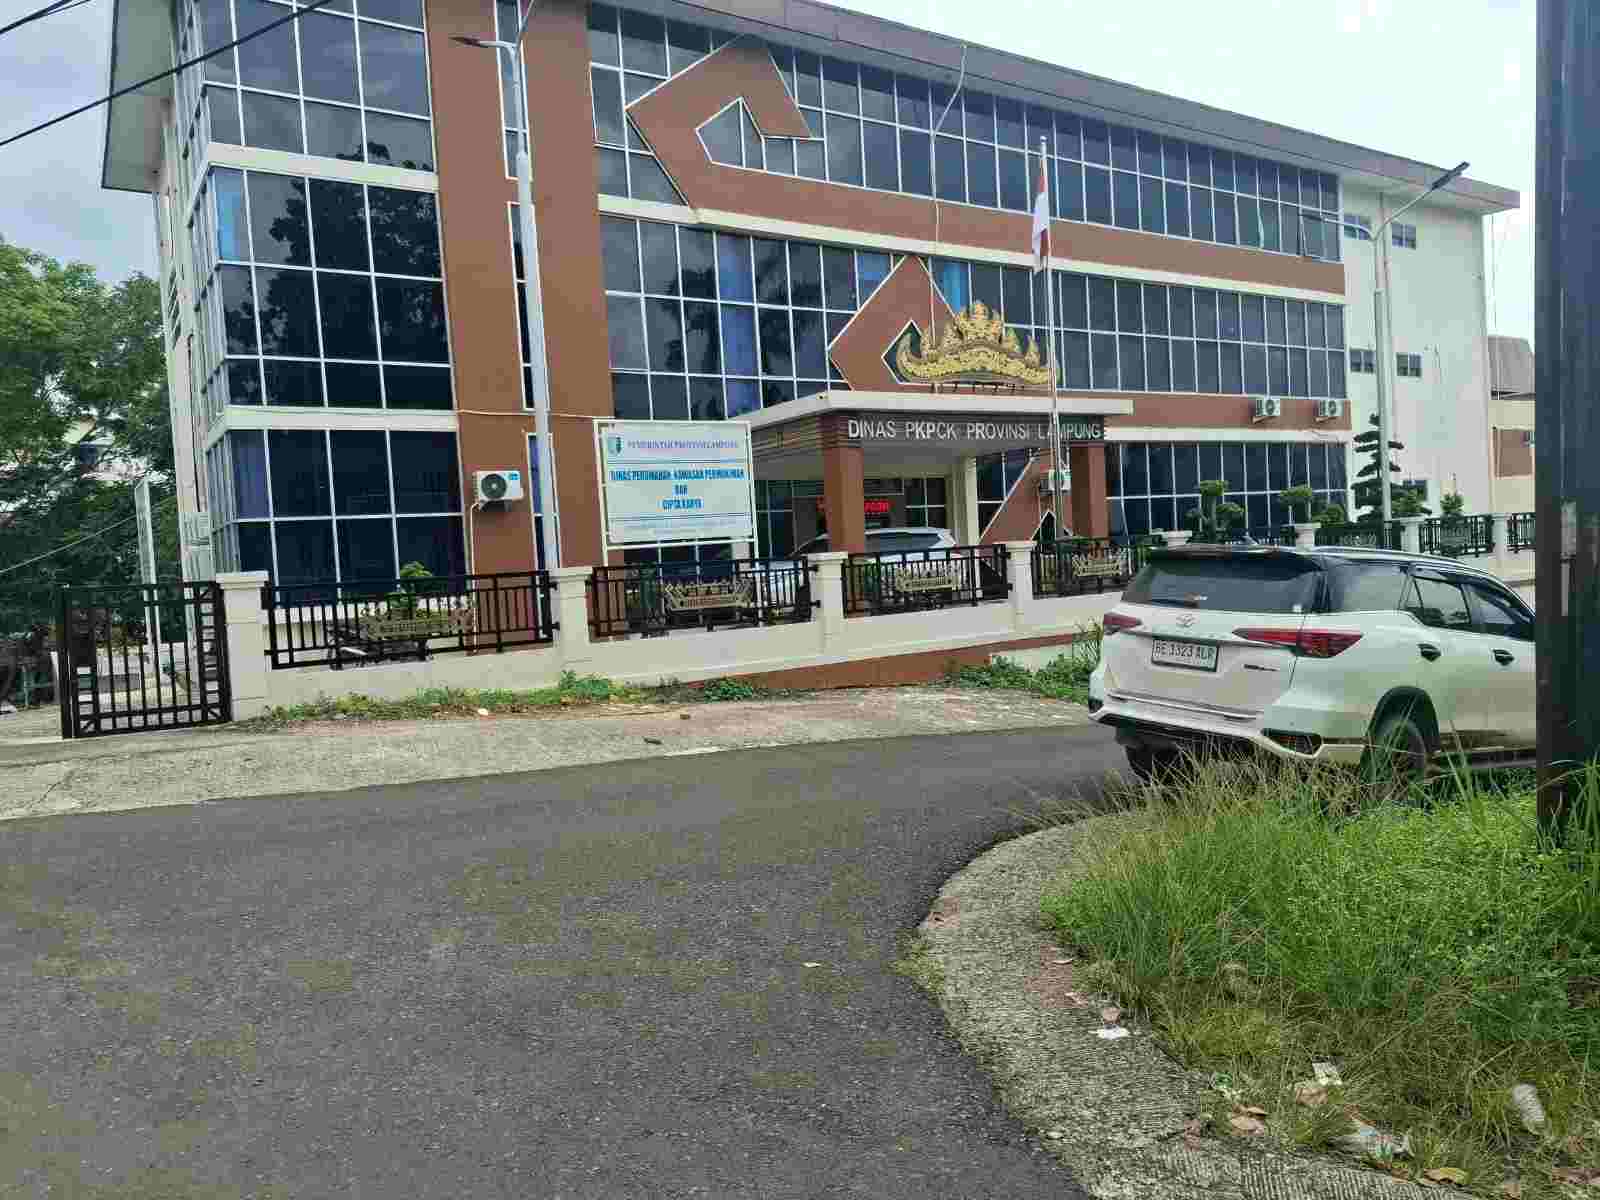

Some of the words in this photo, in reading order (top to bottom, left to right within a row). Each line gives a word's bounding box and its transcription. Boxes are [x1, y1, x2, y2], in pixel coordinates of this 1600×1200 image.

[847, 419, 896, 439] DINAS
[905, 421, 960, 440] PKPCK
[967, 422, 1030, 440] PROVINSI
